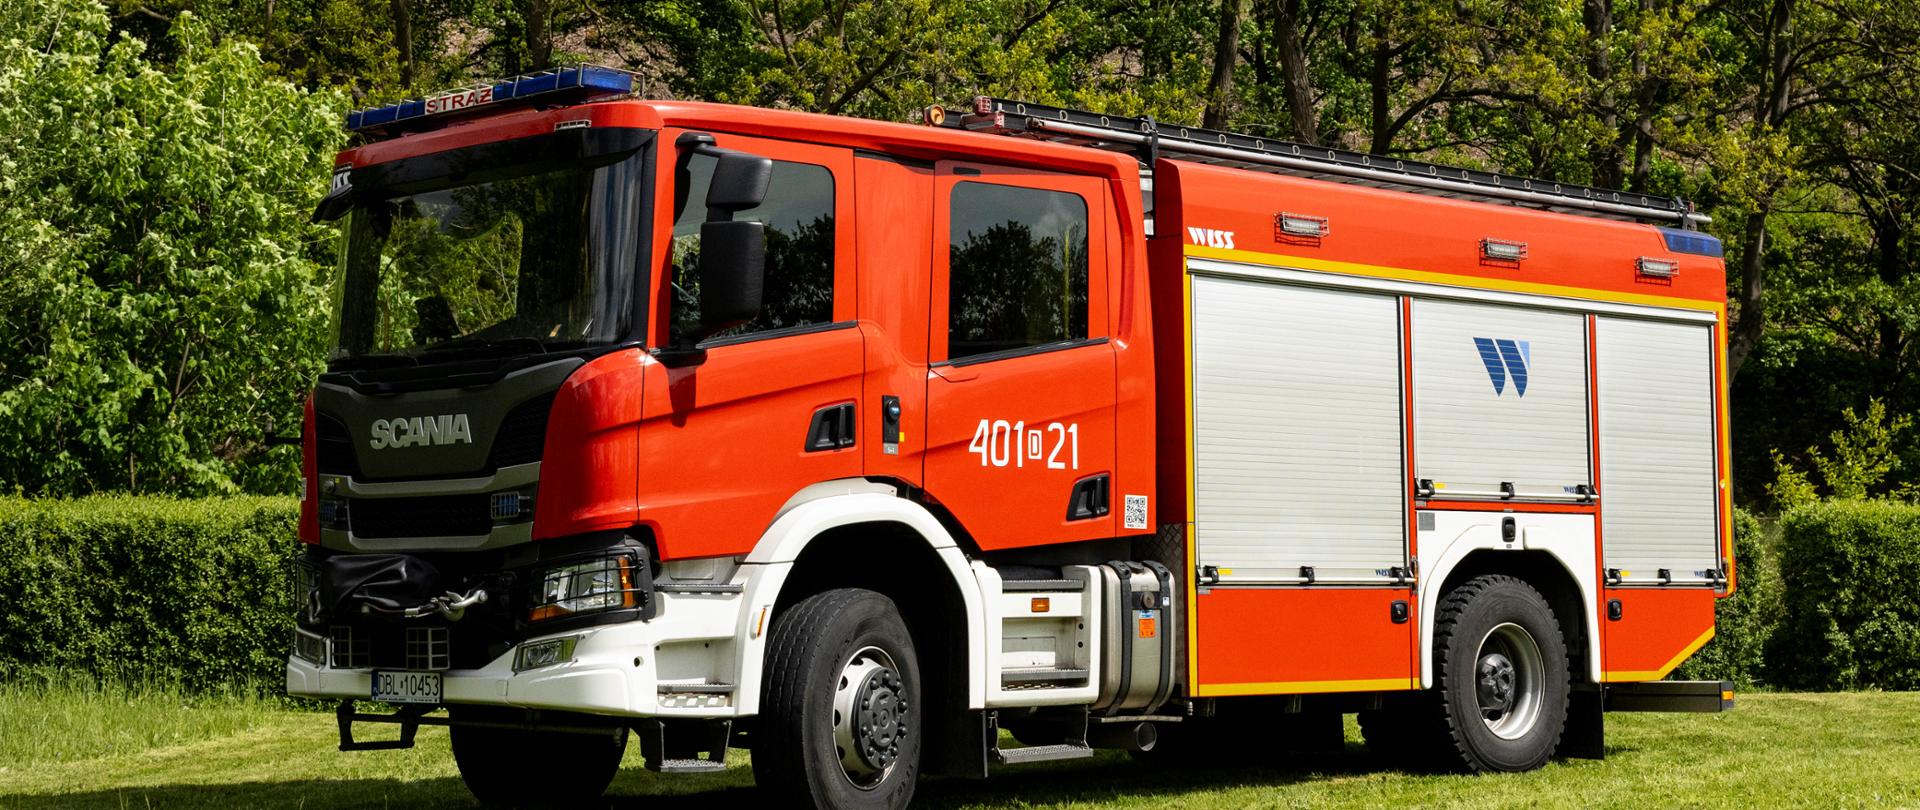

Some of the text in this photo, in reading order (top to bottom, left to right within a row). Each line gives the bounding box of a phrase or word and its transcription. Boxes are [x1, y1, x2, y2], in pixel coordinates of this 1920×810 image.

[1187, 226, 1234, 249] WISS
[370, 413, 472, 449] SCANIA
[378, 674, 440, 696] DBL 10453
